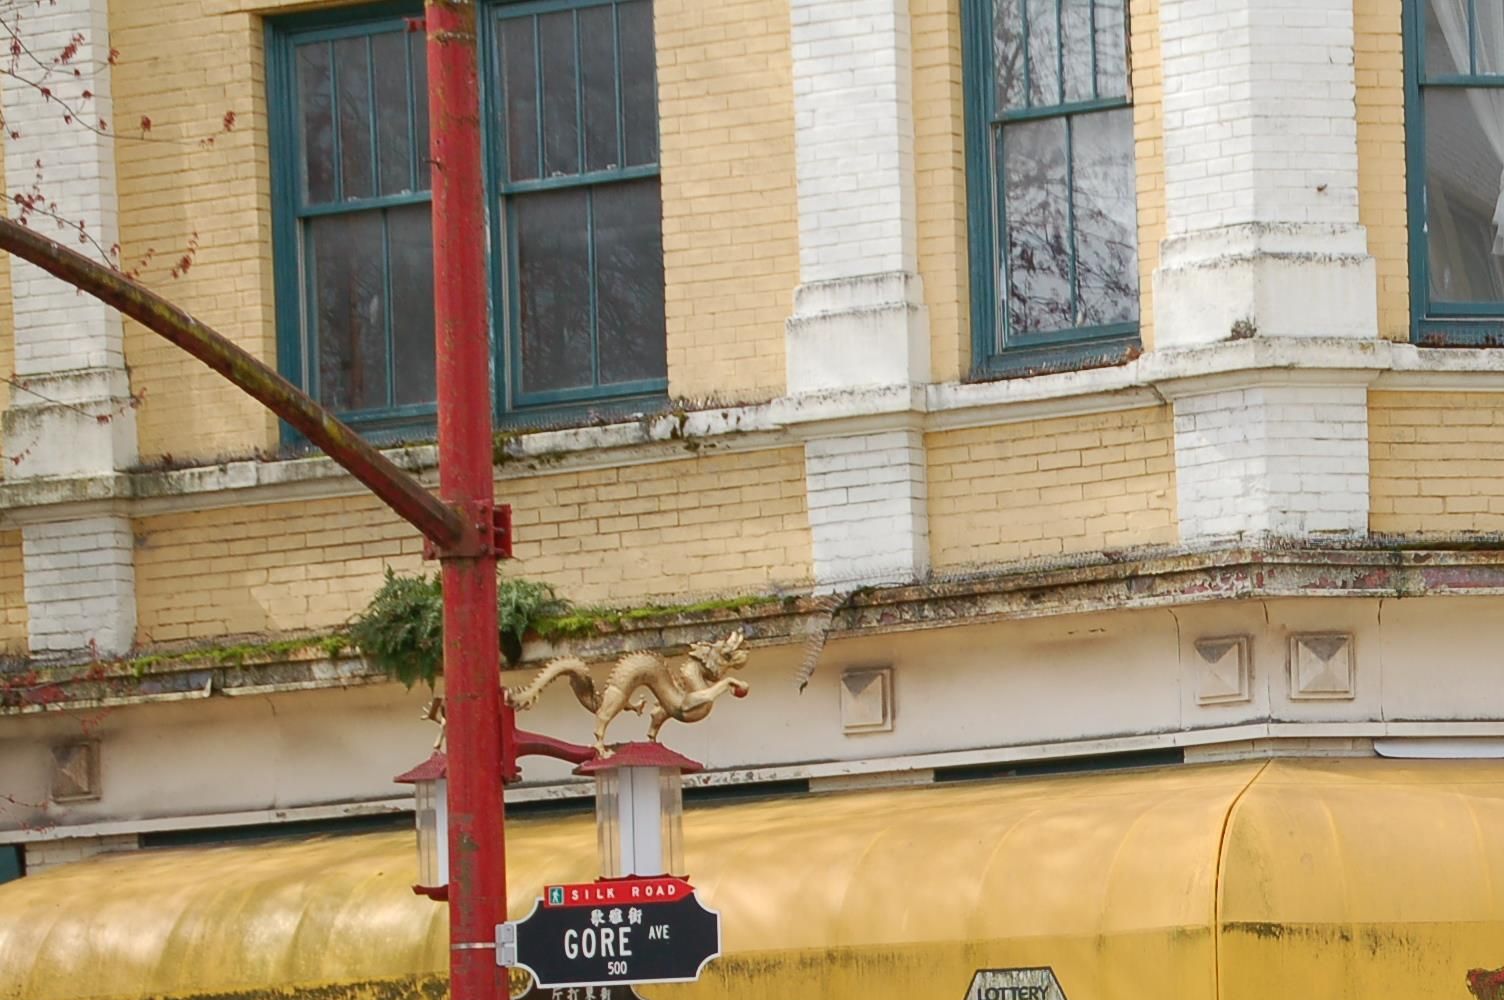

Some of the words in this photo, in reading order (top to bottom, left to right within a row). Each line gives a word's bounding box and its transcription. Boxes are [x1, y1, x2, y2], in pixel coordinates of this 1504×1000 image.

[572, 887, 615, 900] SILK
[632, 884, 676, 898] ROAD
[564, 927, 632, 960] GORE
[649, 925, 670, 940] AVE
[608, 961, 627, 976] 500
